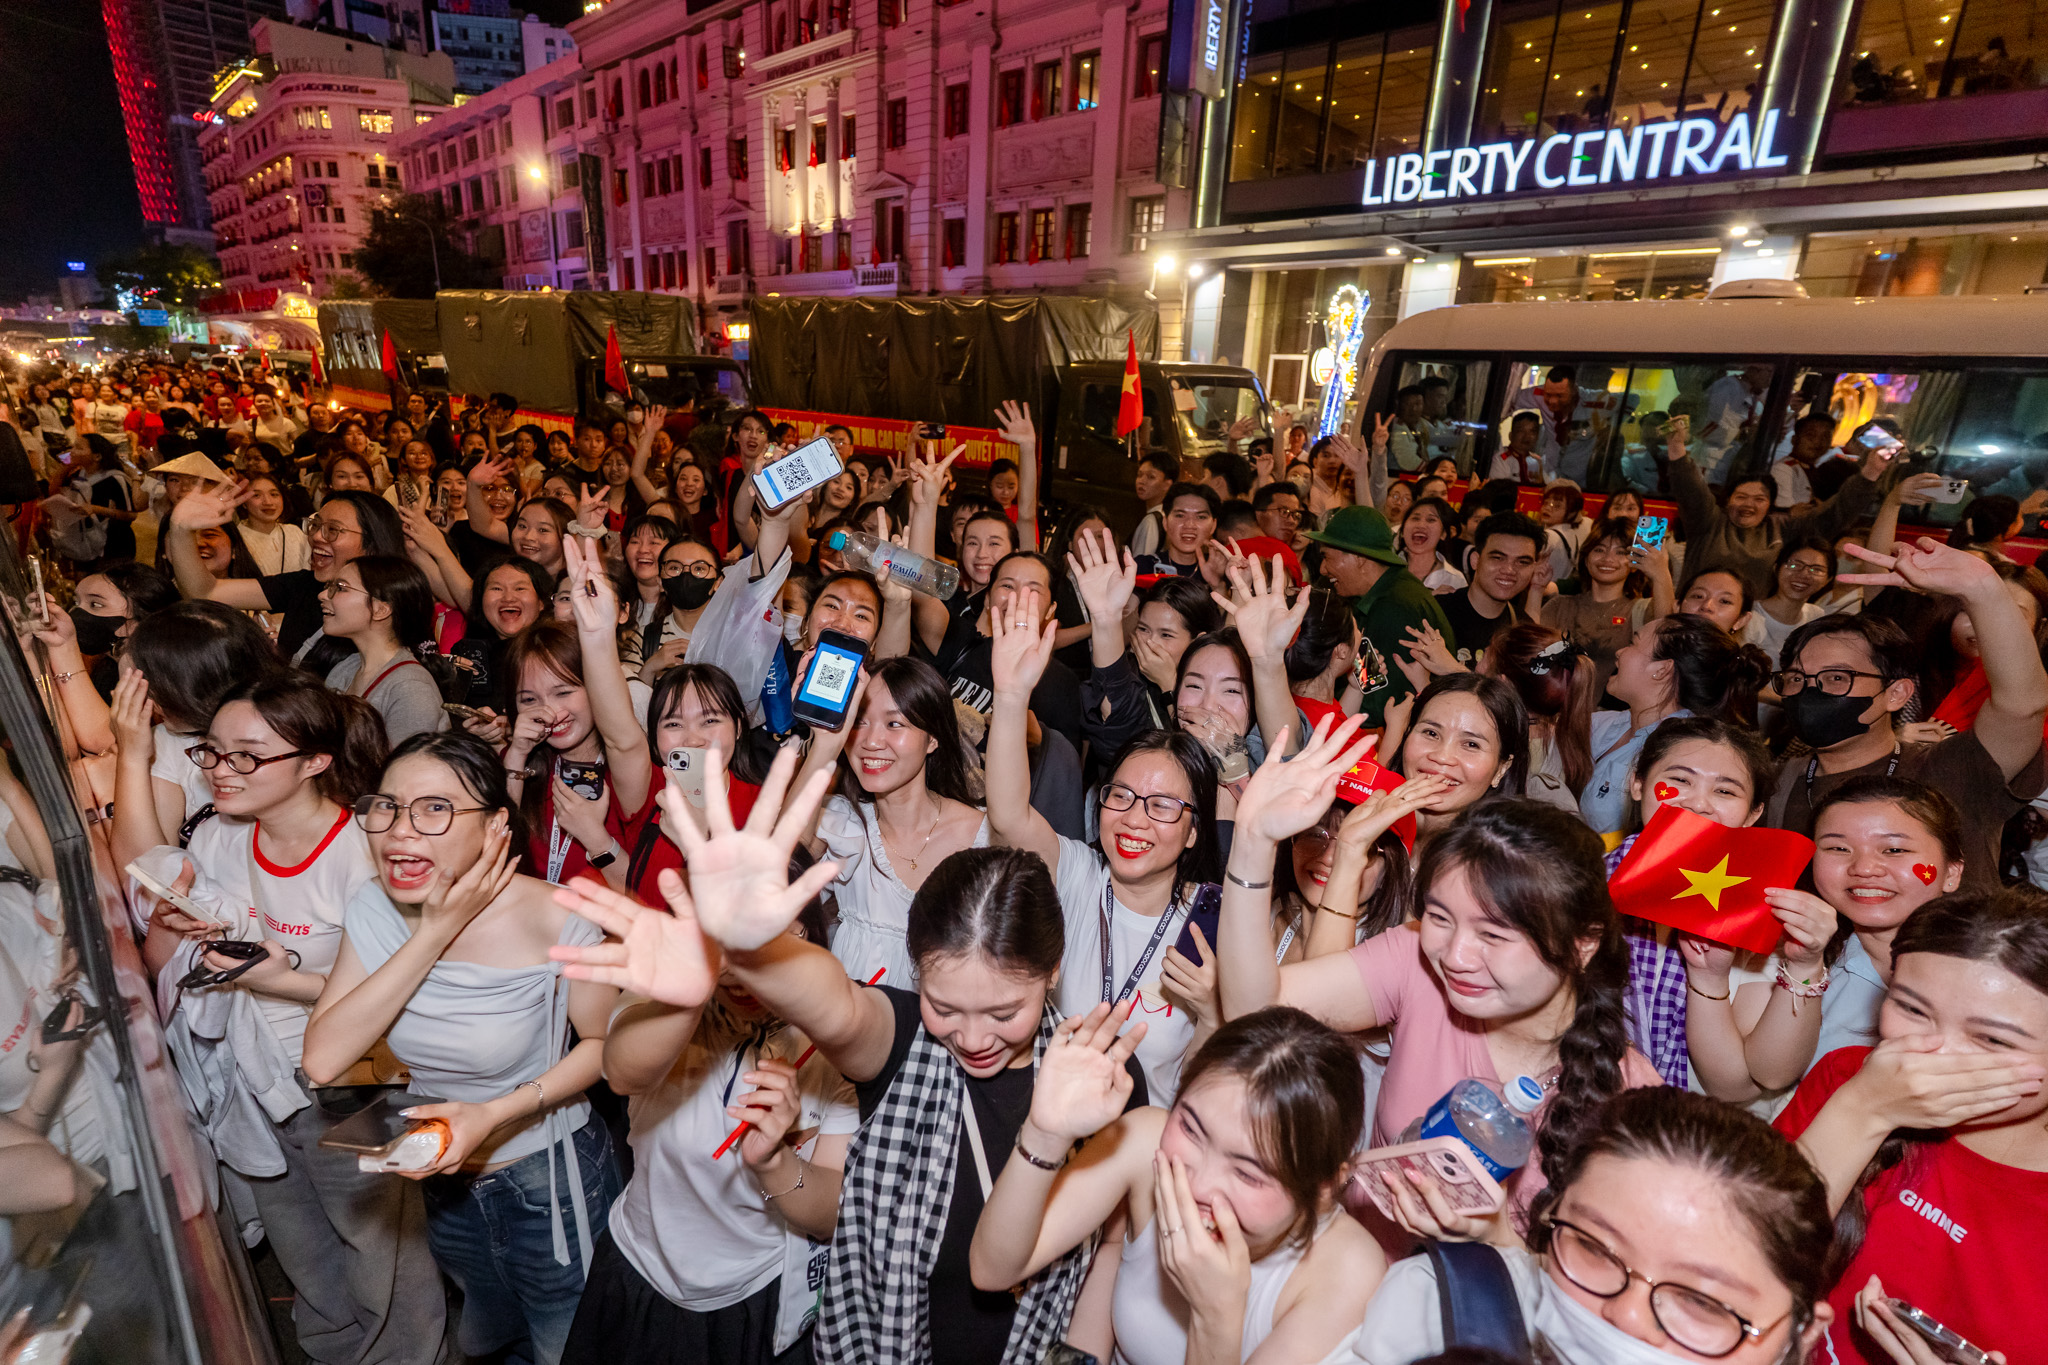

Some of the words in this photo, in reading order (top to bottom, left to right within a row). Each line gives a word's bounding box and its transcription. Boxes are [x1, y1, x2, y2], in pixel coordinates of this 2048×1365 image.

[1361, 138, 1536, 206] LIBERTY
[1535, 108, 1789, 189] CENTRAL
[1349, 781, 1373, 796] NAM
[1898, 1189, 1968, 1244] GIMME
